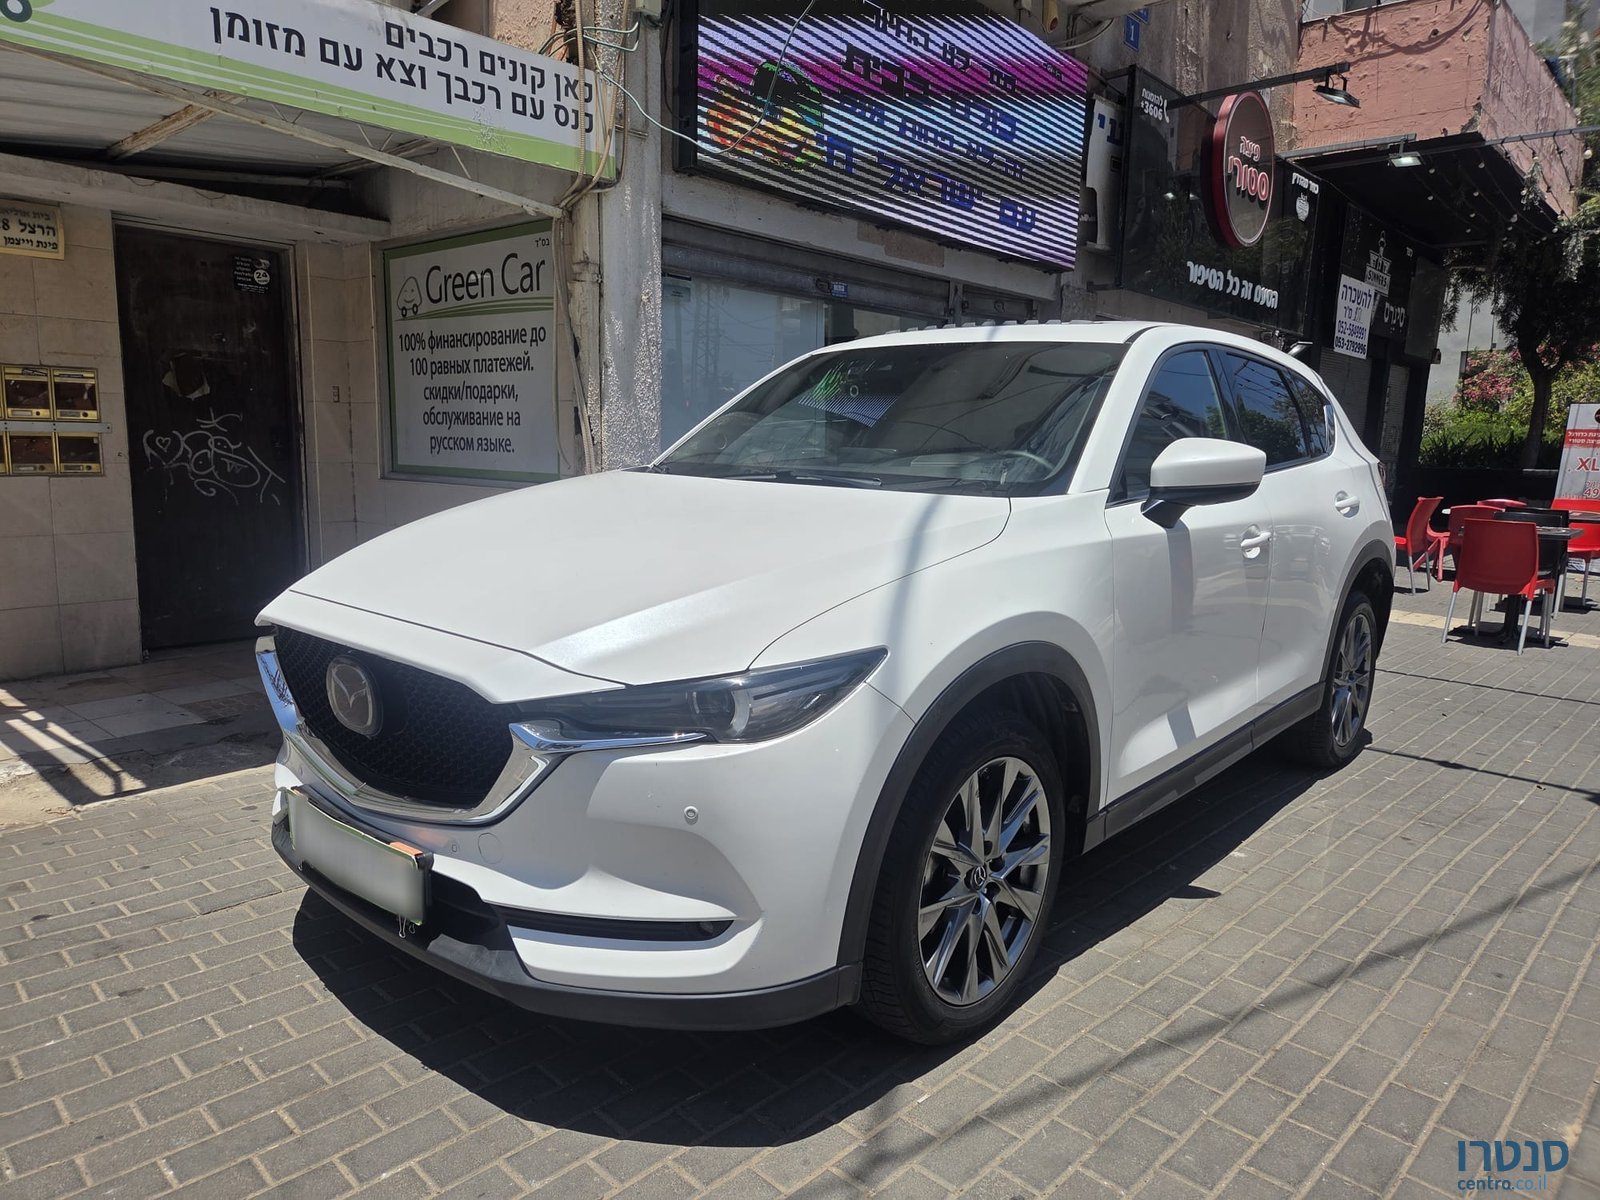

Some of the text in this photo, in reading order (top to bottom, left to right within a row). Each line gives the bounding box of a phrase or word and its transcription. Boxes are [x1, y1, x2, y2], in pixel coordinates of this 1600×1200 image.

[209, 6, 593, 134] כנס עם רכבך וצא עם מזומן
[385, 21, 593, 103] כאן קונים רכבים
[1240, 135, 1261, 162] פיצה
[1227, 155, 1270, 201] סטורי
[18, 219, 56, 237] הרצל
[999, 198, 1036, 233] עם
[3, 236, 58, 250] פינת וייצמן
[425, 252, 546, 304] Green Car
[1186, 261, 1224, 291] הסיפור
[1226, 269, 1240, 296] כל
[1341, 284, 1373, 309] להשכרה
[399, 326, 546, 355] 100% финансирование до
[410, 351, 534, 380] 100 равных платежей.
[423, 380, 519, 404] скидки/подарки,
[423, 406, 521, 430] обслуживание на
[430, 434, 515, 455] русском языке.
[1576, 456, 1600, 472] XL
